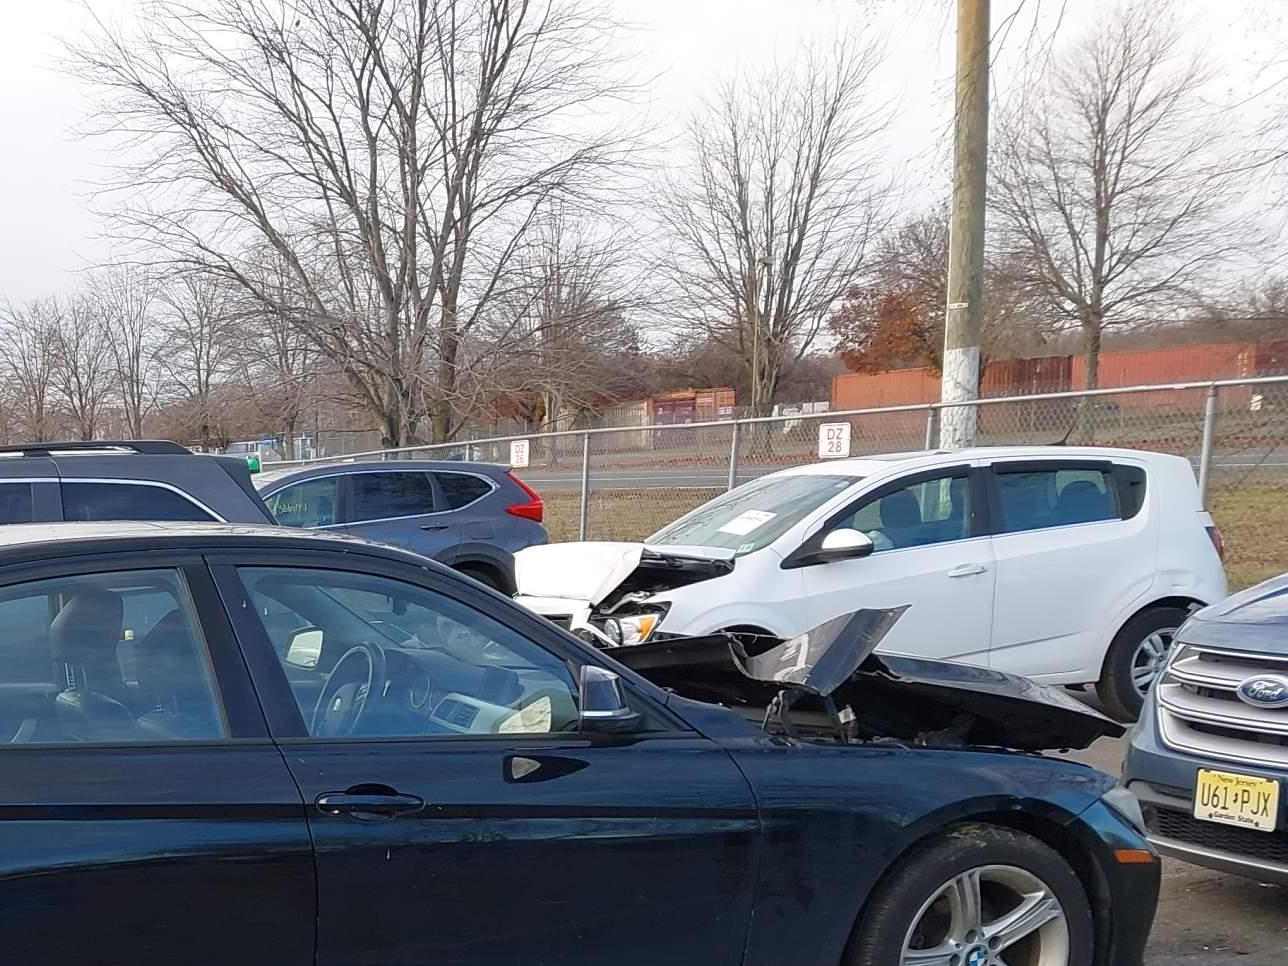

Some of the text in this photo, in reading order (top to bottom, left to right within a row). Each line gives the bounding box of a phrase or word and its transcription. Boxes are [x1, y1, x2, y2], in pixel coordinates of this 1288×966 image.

[827, 427, 843, 440] DZ
[828, 441, 842, 452] 28
[1248, 680, 1284, 698] Ford
